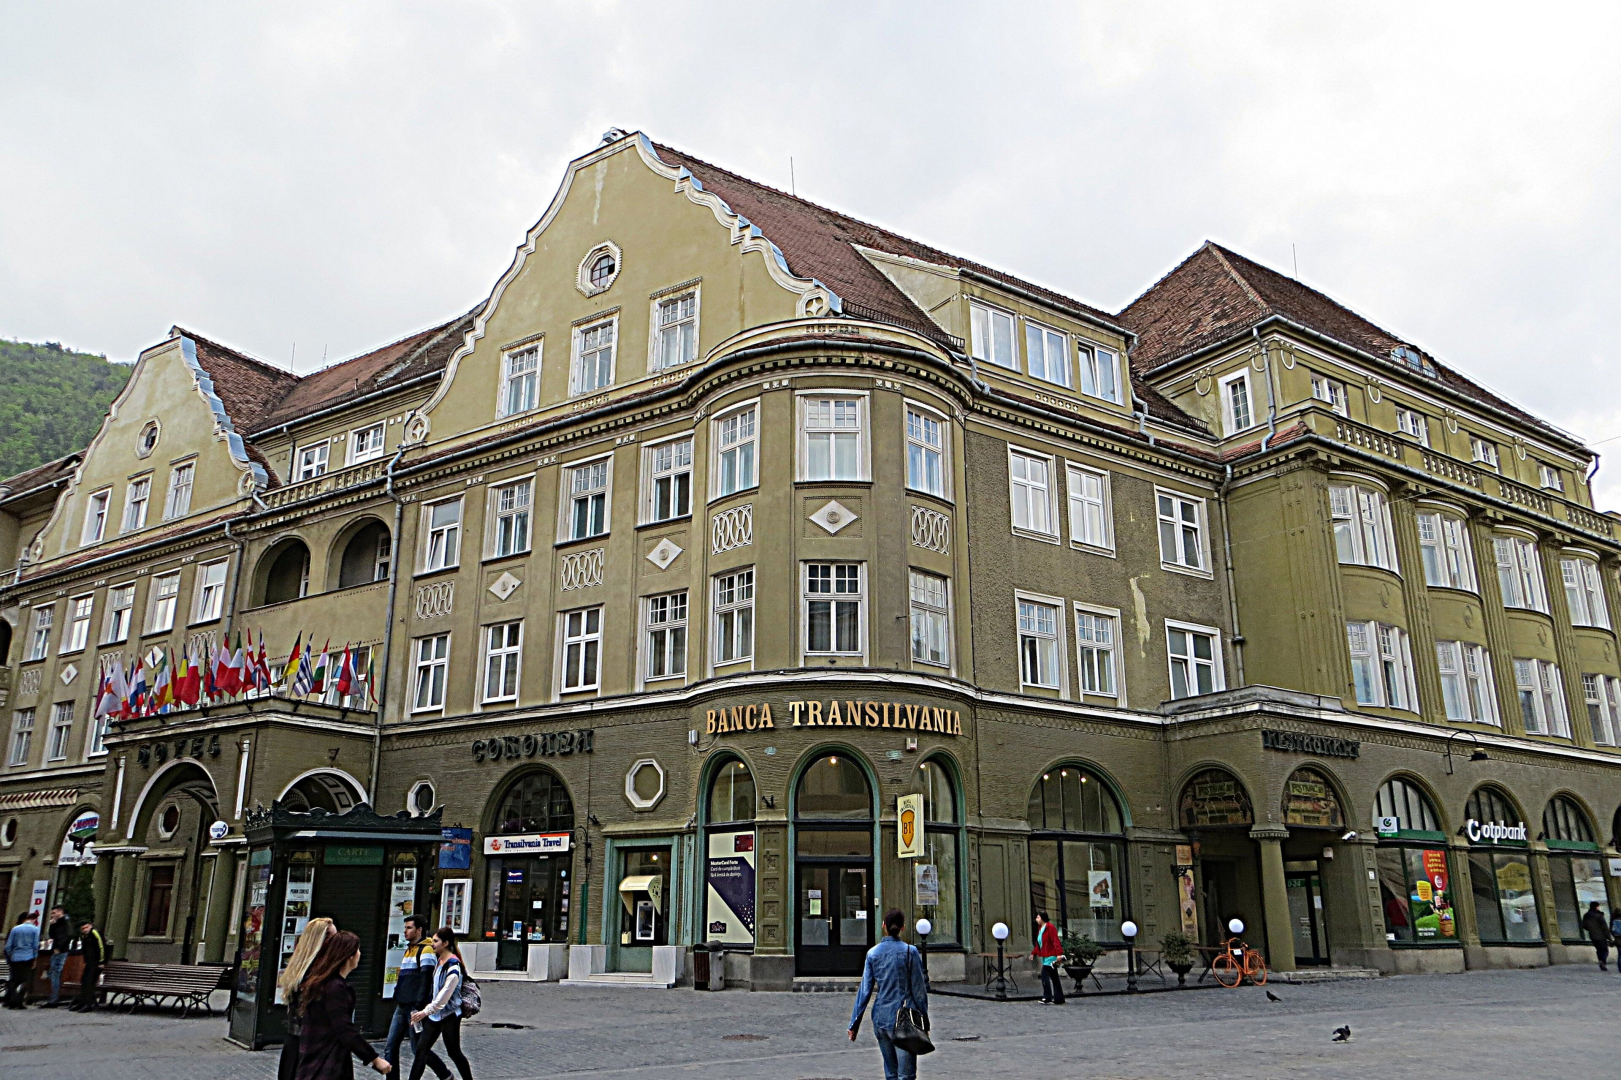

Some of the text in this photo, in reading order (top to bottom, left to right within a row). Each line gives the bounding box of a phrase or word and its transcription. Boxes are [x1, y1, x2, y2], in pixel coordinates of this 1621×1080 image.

[706, 700, 963, 736] BANCA TRANSILVANIA
[903, 822, 913, 835] BT
[1481, 820, 1527, 844] otpbank
[504, 838, 562, 849] Transilvania Travel
